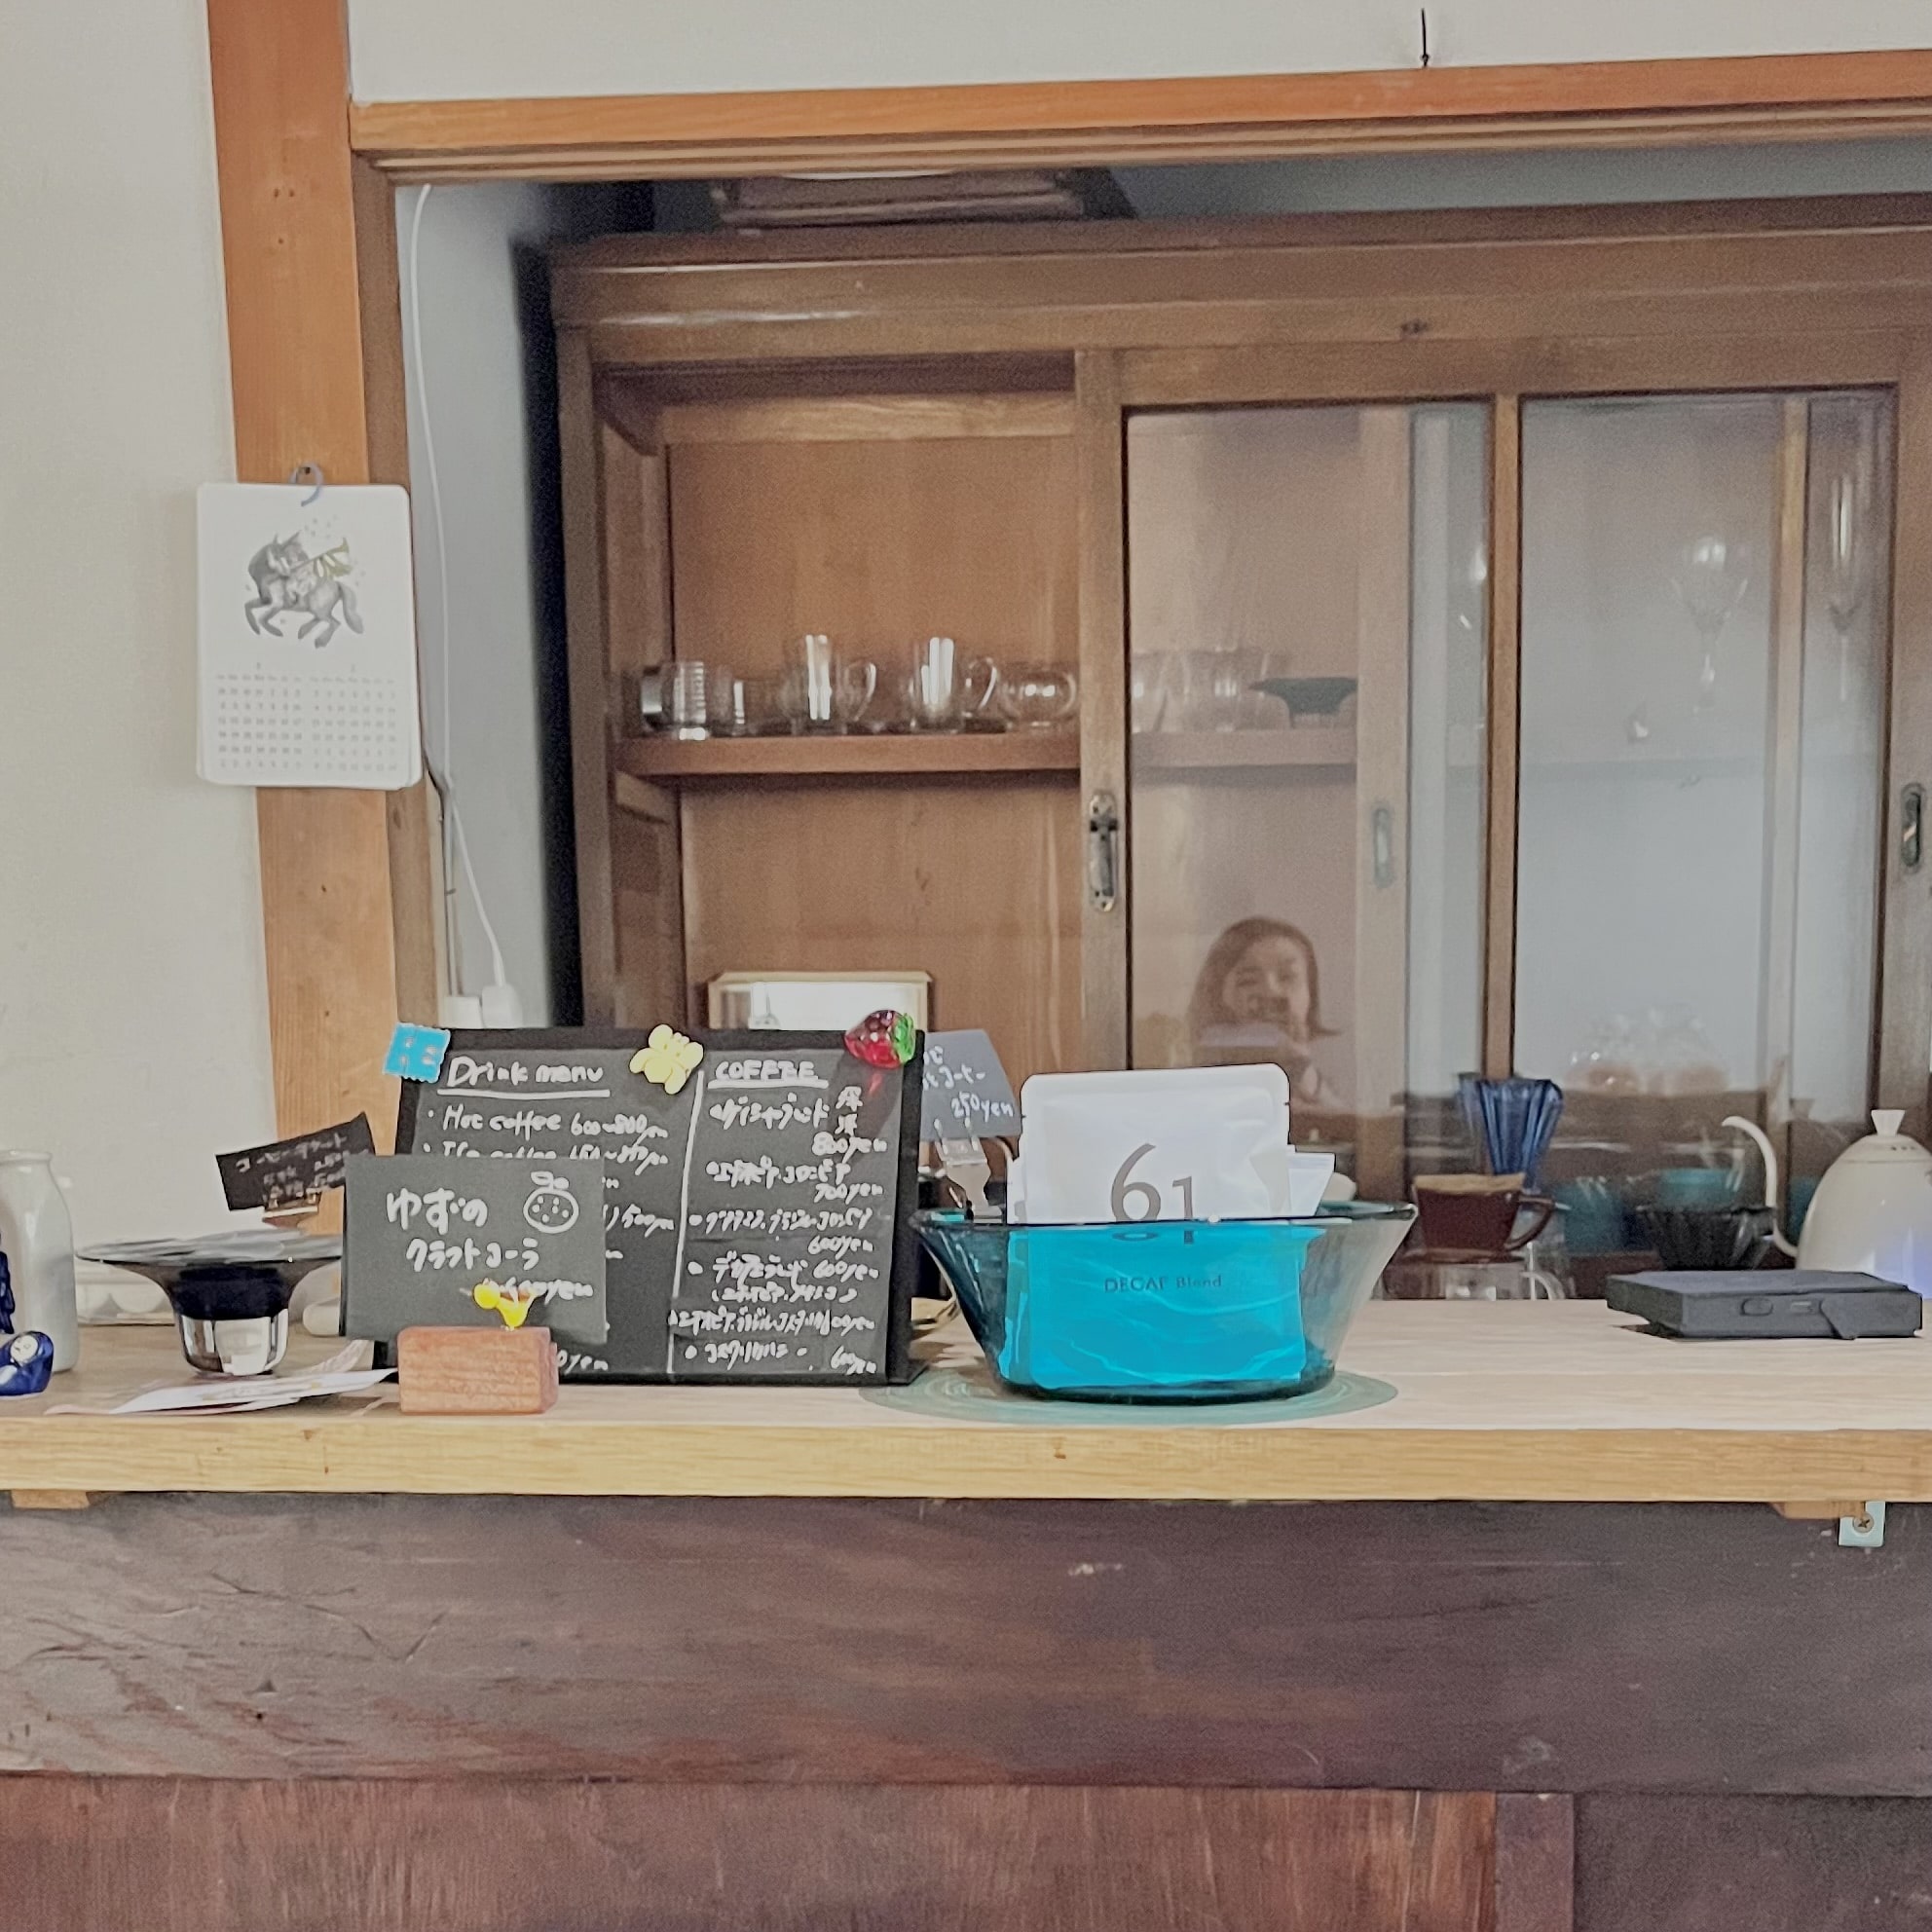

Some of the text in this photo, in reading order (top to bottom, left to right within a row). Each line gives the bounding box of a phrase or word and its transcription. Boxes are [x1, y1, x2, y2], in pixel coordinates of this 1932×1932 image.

[447, 1056, 528, 1087] Drink
[951, 1091, 1013, 1123] 250yen
[489, 1110, 561, 1140] coffee
[1110, 1142, 1196, 1245] 61
[386, 1187, 489, 1235] ゆずの
